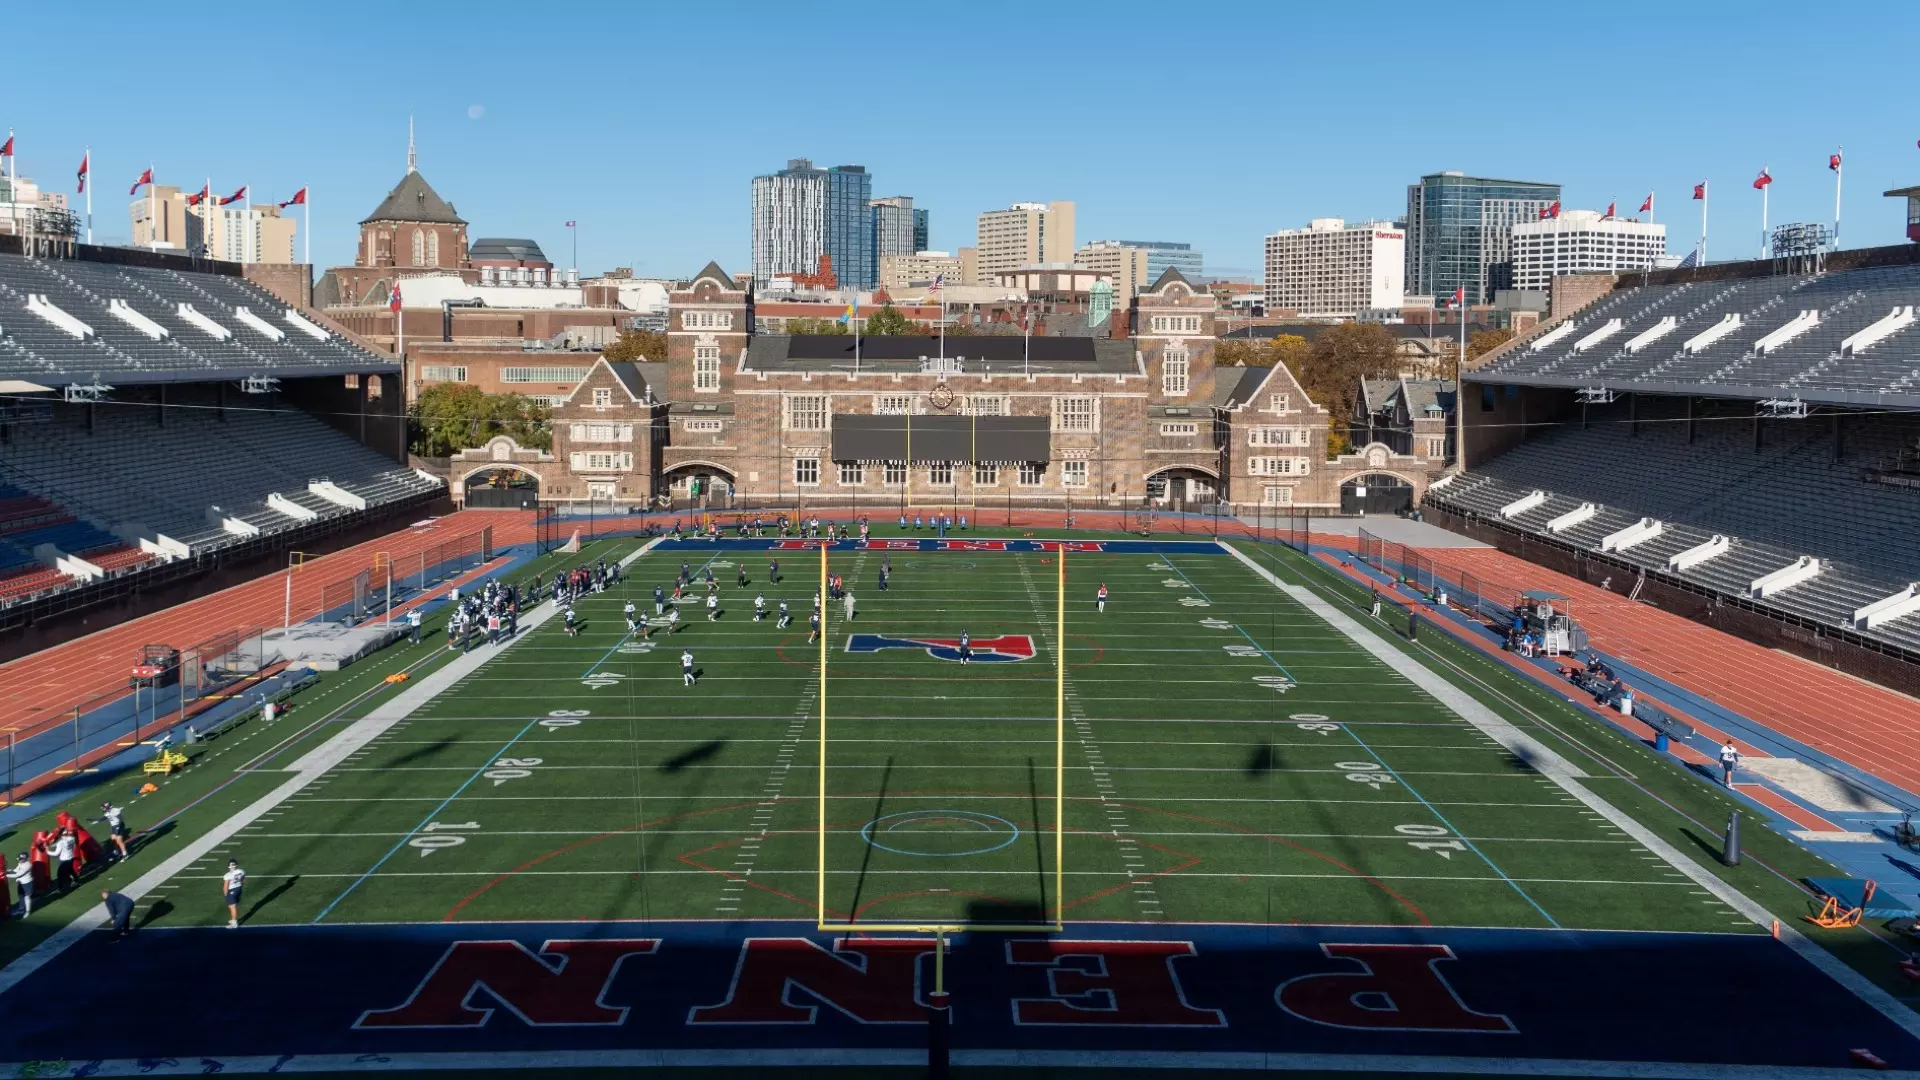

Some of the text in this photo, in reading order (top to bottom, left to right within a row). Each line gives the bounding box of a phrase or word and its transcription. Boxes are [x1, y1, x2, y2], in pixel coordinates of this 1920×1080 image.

[1375, 231, 1403, 239] Sheraton
[769, 540, 1107, 552] PENN
[539, 710, 591, 726] 30
[1289, 714, 1340, 731] 30
[483, 758, 543, 779] 20
[409, 821, 480, 847] 10
[1394, 824, 1467, 850] 10
[352, 938, 1520, 1033] PENN
